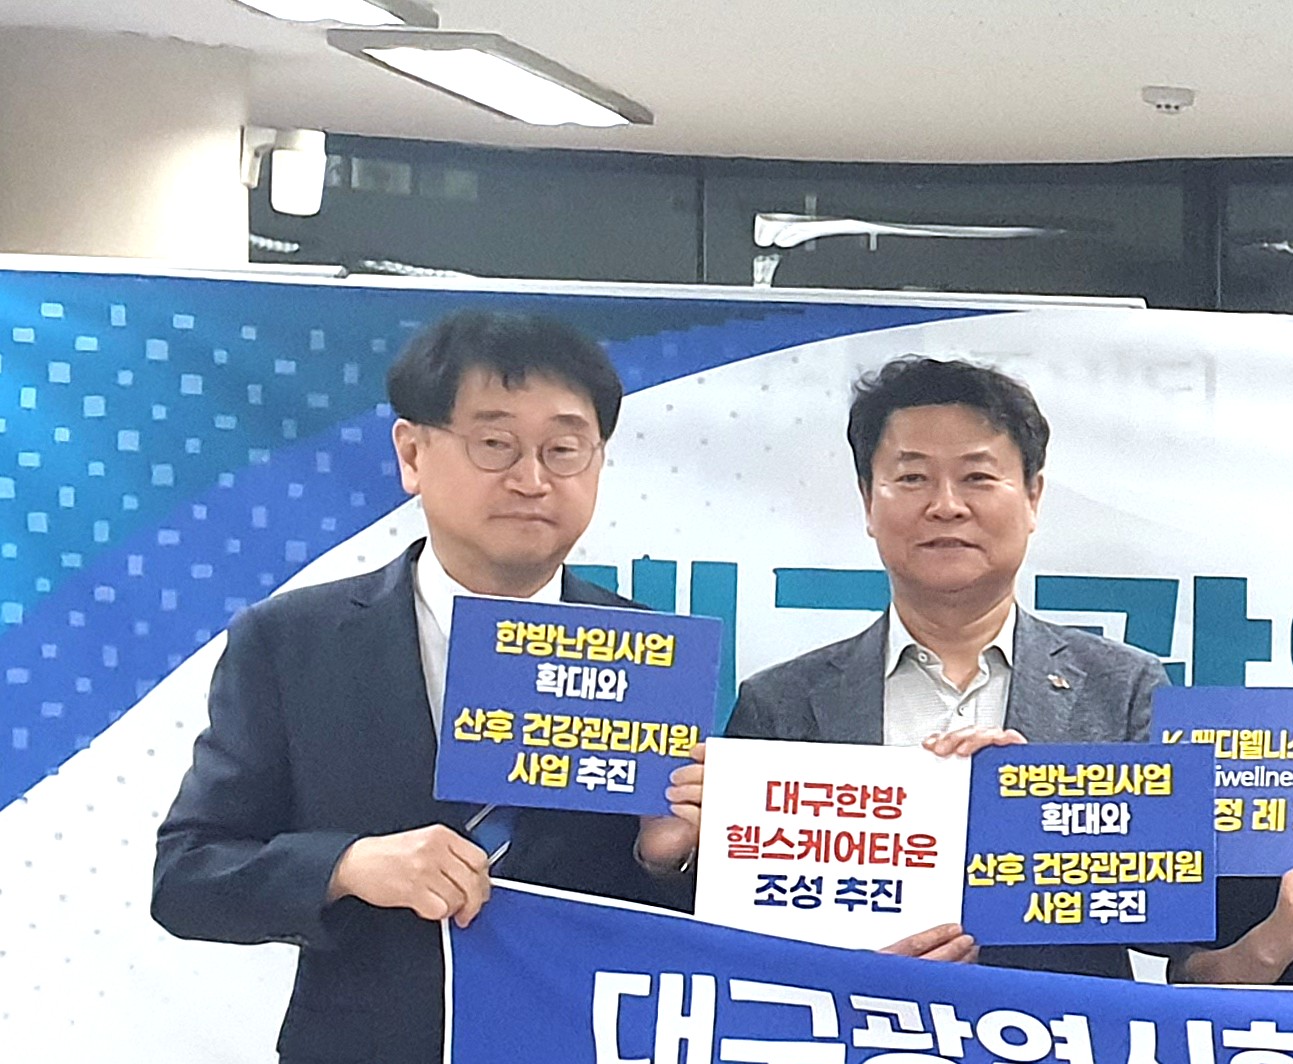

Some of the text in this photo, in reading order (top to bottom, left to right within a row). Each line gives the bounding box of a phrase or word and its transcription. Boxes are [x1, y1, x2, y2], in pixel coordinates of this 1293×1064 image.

[495, 620, 674, 667] 한방난임사업
[535, 662, 628, 702] 확대와
[454, 707, 698, 757] 산후 건강관리지원
[507, 751, 636, 793] 사업 추진
[998, 763, 1171, 797] 한방난임사업
[765, 780, 908, 820] 대구한방
[1041, 802, 1131, 836] 확대와
[726, 824, 938, 869] 헬스케어타운
[966, 850, 1202, 886] 산후 건강관리지원
[753, 873, 903, 914] 조성 추진
[1023, 889, 1146, 924] 사업 추진
